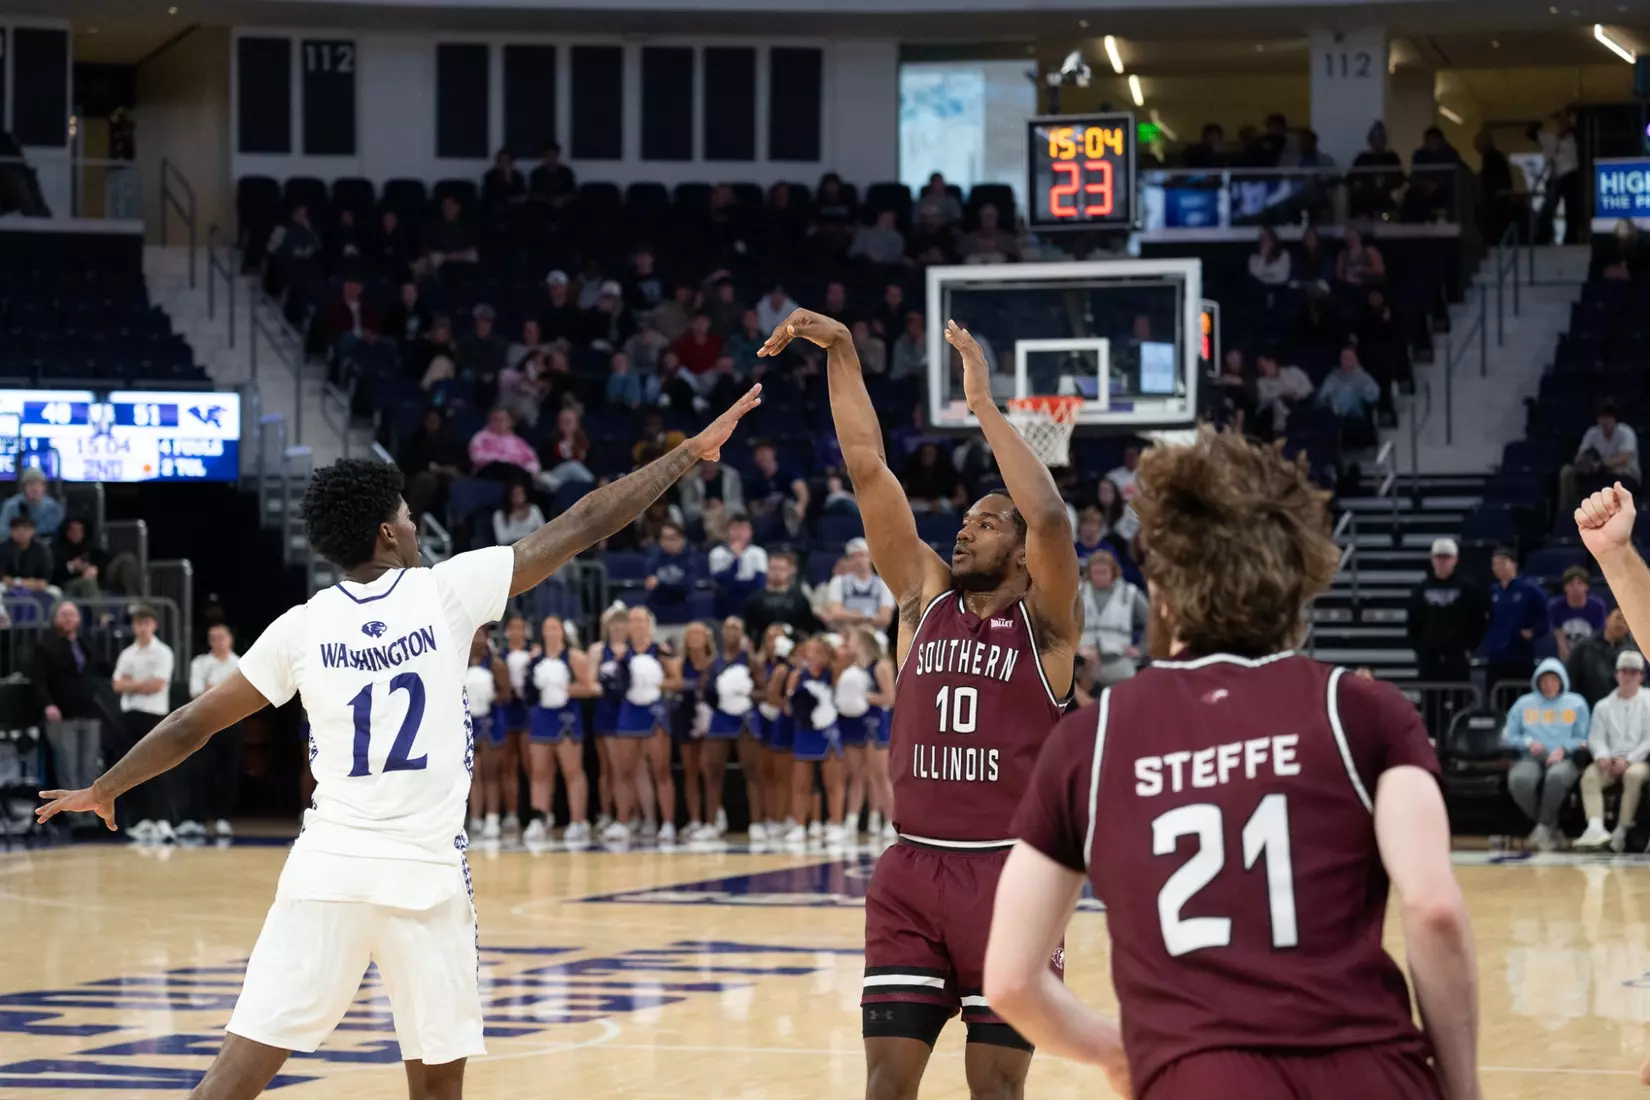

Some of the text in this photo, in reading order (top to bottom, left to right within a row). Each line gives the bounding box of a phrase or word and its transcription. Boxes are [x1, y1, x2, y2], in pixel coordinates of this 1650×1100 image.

[305, 44, 353, 73] 112
[1325, 51, 1373, 79] 112
[1048, 126, 1123, 160] 15:04
[1049, 160, 1113, 217] 23
[319, 625, 437, 672] WASHINGTON
[916, 639, 1019, 683] SOUTHERN
[347, 671, 428, 777] 12
[935, 685, 978, 734] 10
[913, 743, 999, 782] ILLINOIS
[1134, 733, 1301, 797] STEFFE
[1151, 793, 1299, 957] 21
